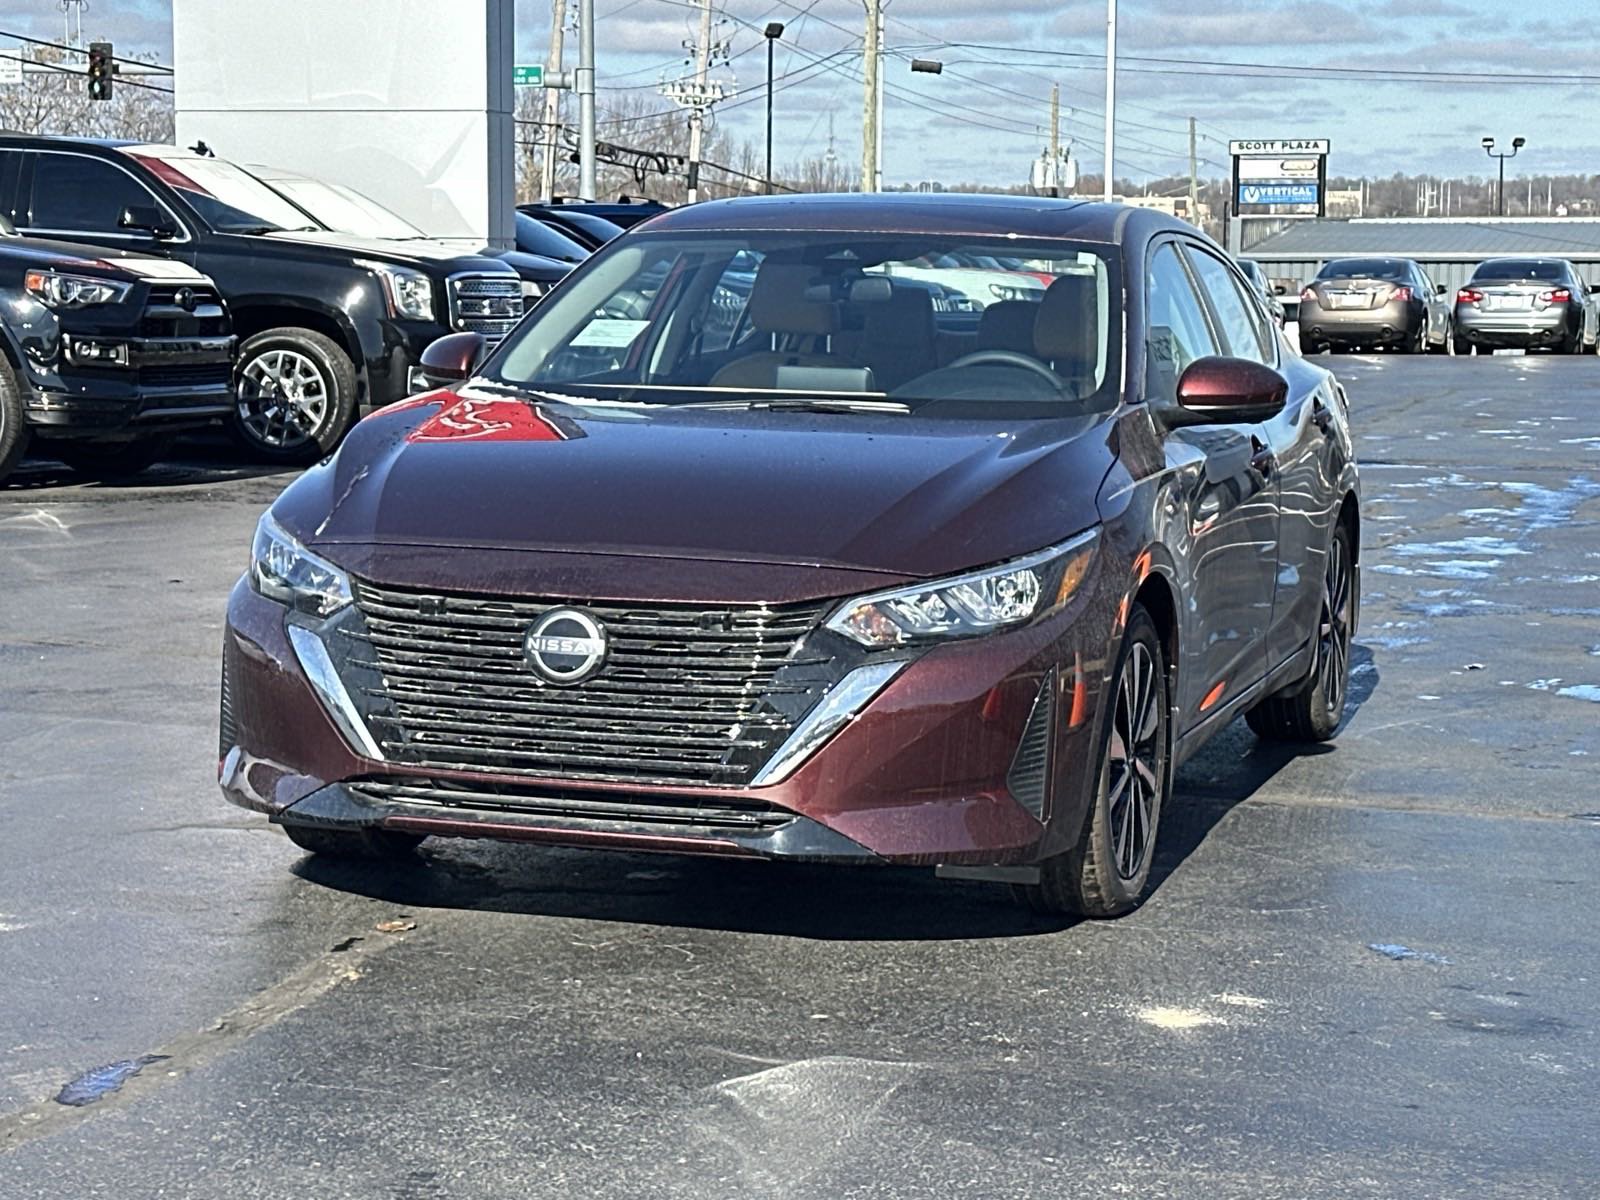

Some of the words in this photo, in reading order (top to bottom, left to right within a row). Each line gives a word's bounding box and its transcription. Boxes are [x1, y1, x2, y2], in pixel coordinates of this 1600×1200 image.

[1238, 142, 1276, 150] SCOTT
[1281, 141, 1320, 150] PLAZA
[1259, 187, 1312, 196] VERTICAL
